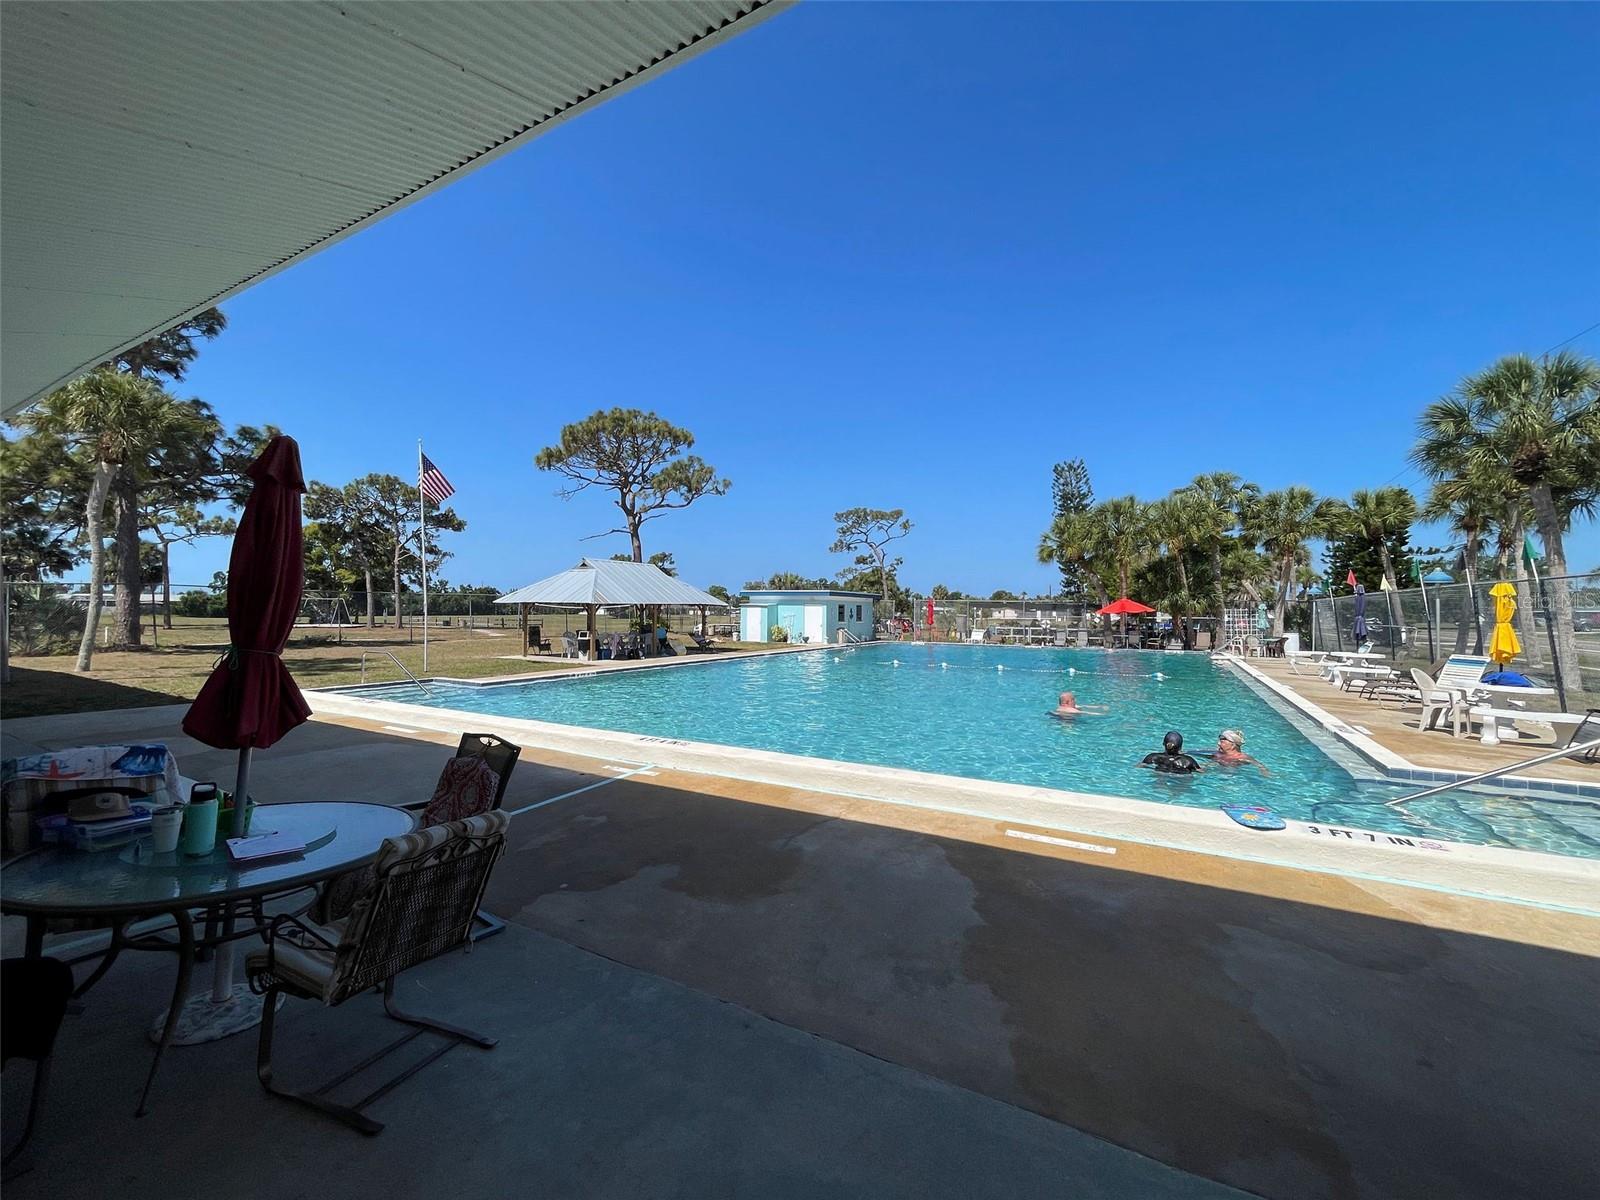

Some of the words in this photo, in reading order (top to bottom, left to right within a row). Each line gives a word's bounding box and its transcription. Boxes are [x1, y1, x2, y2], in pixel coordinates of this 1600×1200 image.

[1308, 826, 1321, 834] 3
[1328, 828, 1353, 839] FT
[1364, 833, 1376, 842] 7
[1388, 836, 1416, 847] IN
